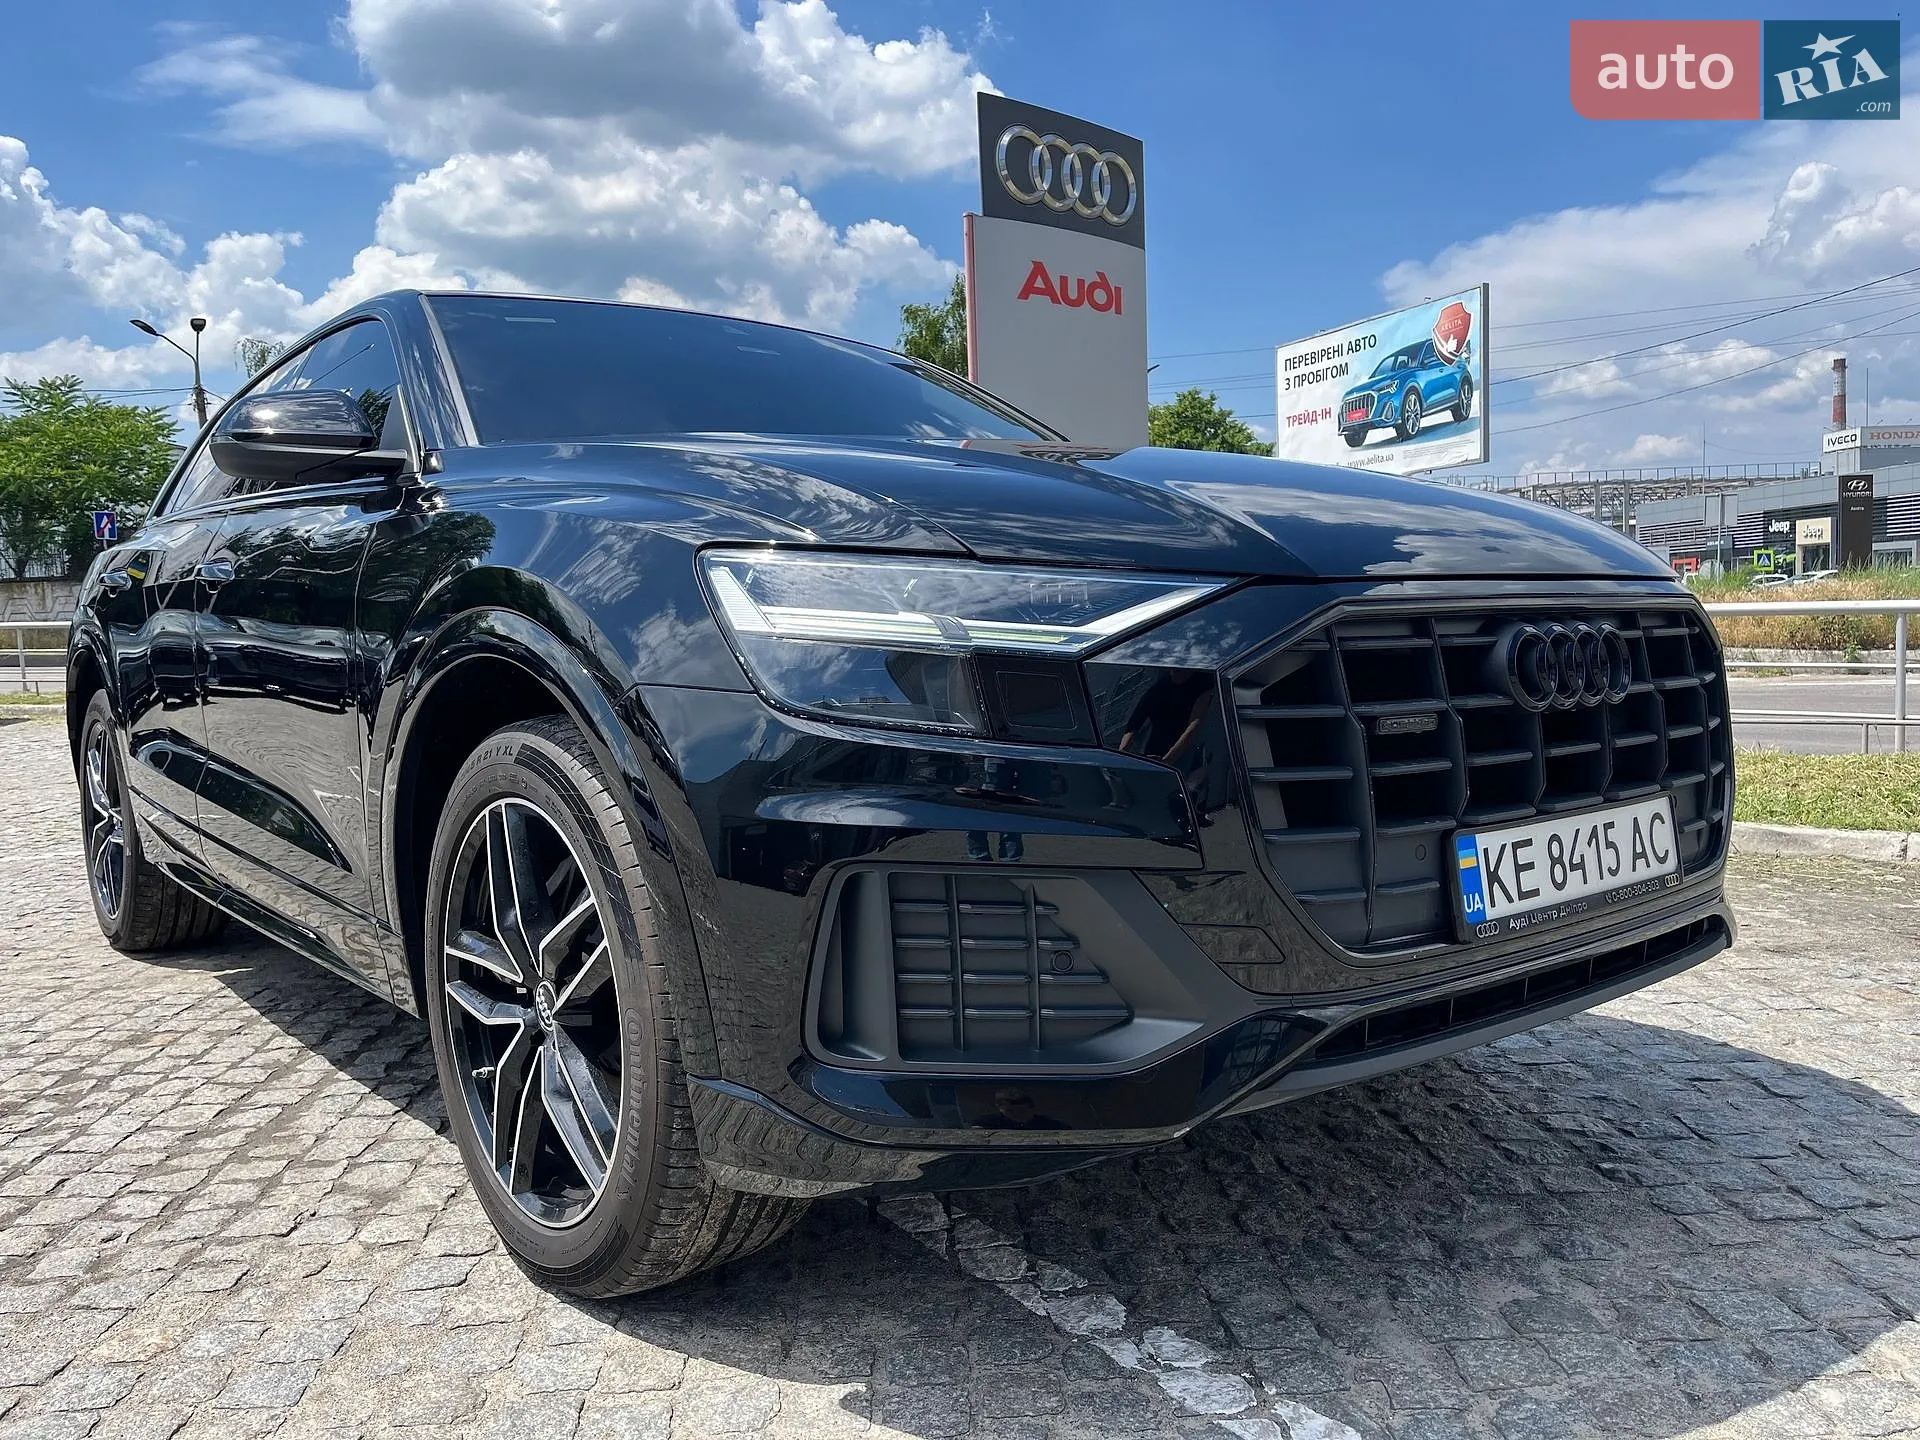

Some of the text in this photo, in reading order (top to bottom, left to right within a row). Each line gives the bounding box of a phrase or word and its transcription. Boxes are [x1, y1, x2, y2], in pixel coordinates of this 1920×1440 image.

[1016, 260, 1123, 315] Audi
[1284, 333, 1377, 372] ПЕРЕВІРЕНІ АВТО
[1284, 362, 1349, 391] З ПРОБІГОМ
[1286, 406, 1332, 429] ТРЕЙД-ІН
[1827, 433, 1857, 447] IVECO
[1769, 519, 1790, 533] Jeep
[1802, 524, 1824, 540] Jeep
[1483, 811, 1669, 909] KE 8415 AC
[1463, 891, 1484, 913] UA
[1508, 914, 1530, 931] Ауді
[1531, 909, 1558, 925] Центр
[1559, 901, 1588, 918] Дніпро
